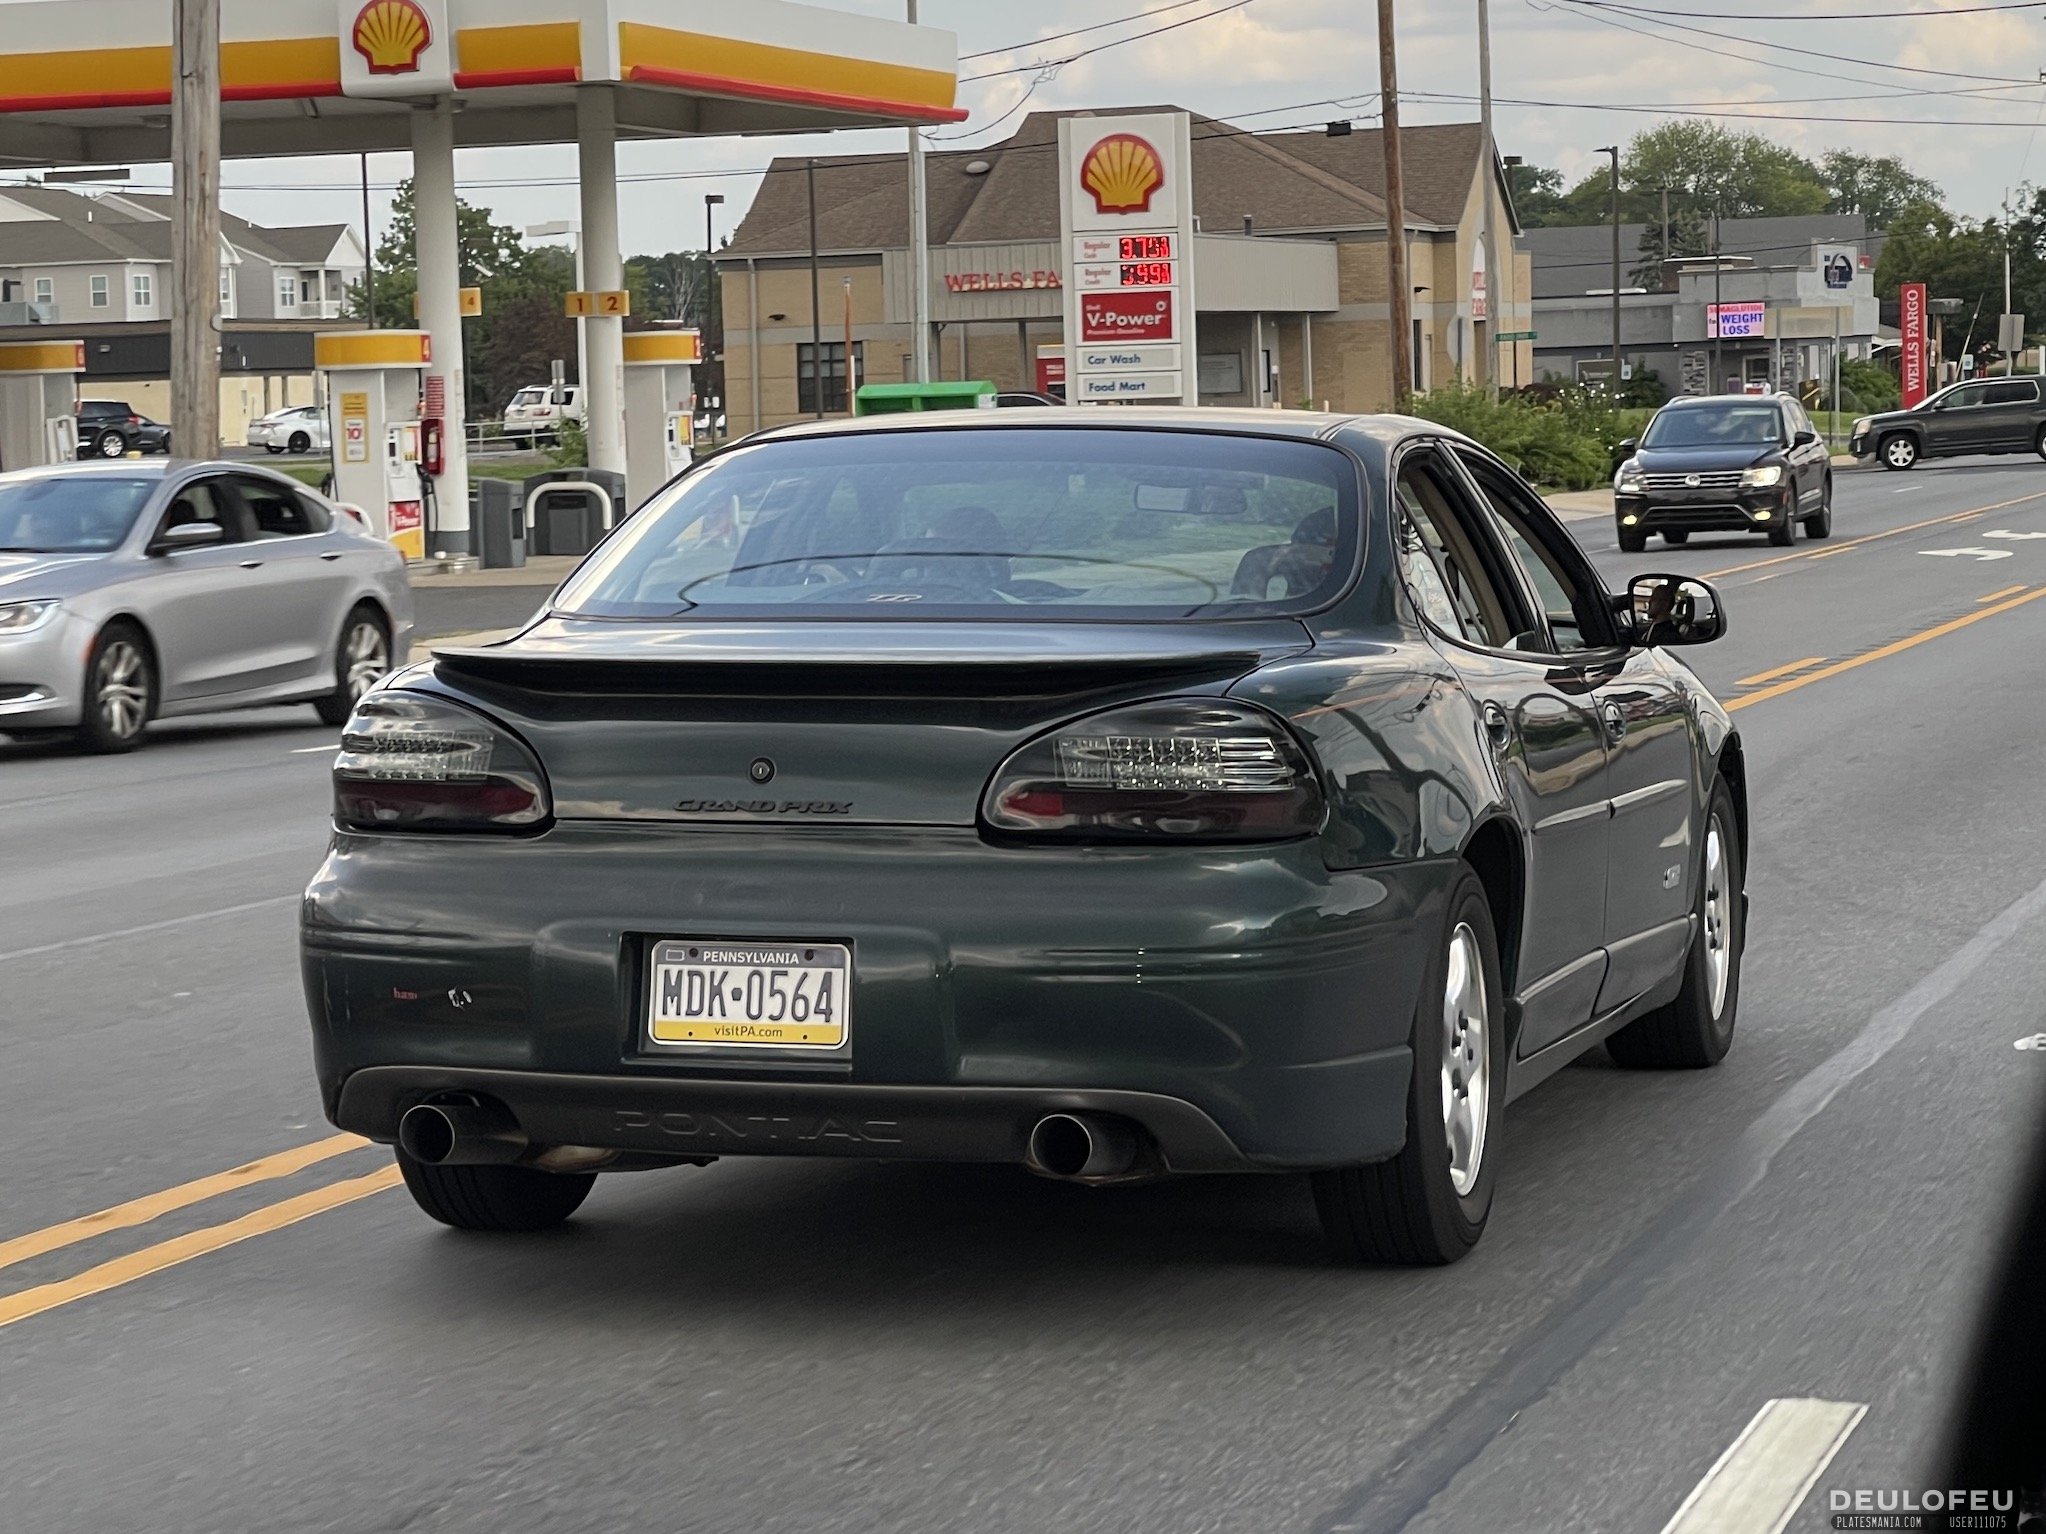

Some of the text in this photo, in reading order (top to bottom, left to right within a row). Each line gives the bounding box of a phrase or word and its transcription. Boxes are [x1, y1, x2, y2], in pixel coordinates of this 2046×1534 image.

[944, 270, 1062, 292] WELLS FA
[577, 298, 583, 312] 1
[607, 296, 618, 311] 2
[1086, 312, 1164, 327] V-Power
[1721, 313, 1763, 323] WEIGHT
[1723, 325, 1750, 335] LOSS
[1907, 289, 1920, 392] WELLS FARGO
[1087, 353, 1141, 365] Car Wash
[1088, 382, 1145, 392] Food Mart
[673, 800, 853, 814] GRAND PRIX
[703, 951, 799, 964] PENNSYLVANIA
[714, 1025, 783, 1038] visitPA.com
[614, 1110, 902, 1143] PONTIAC
